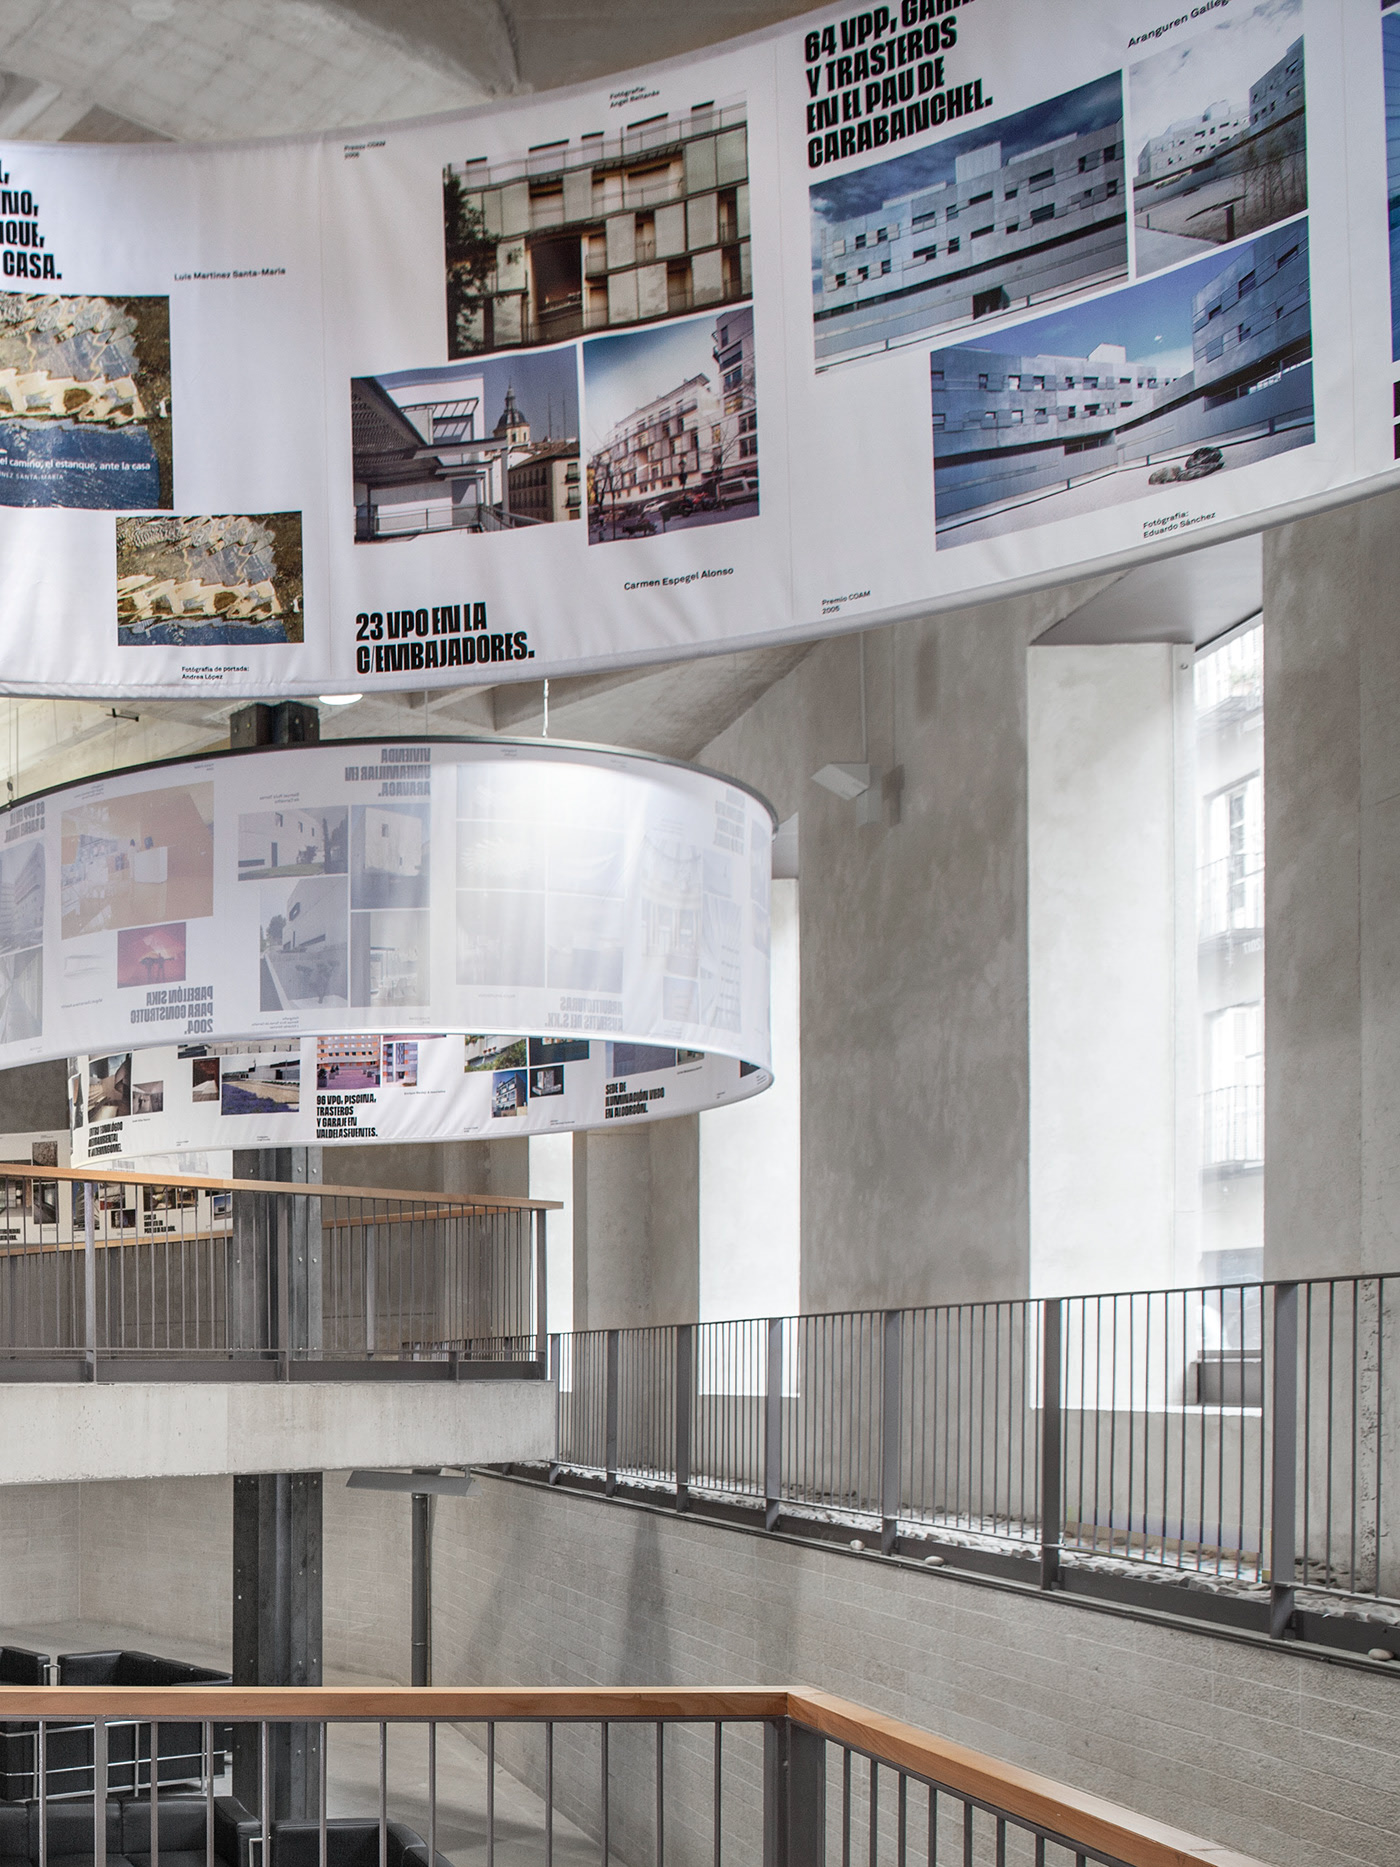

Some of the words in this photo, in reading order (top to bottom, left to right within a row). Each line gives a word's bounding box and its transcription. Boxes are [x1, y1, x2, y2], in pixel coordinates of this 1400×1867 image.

[804, 24, 837, 62] 64
[840, 6, 898, 51] VPP,
[1128, 14, 1188, 48] Aranguren
[806, 65, 821, 98] Y
[826, 16, 957, 92] TRASTEROS
[806, 94, 839, 134] EN
[842, 87, 862, 122] EL
[866, 67, 914, 115] PAU
[918, 56, 945, 96] DE
[808, 78, 993, 168] CARABANCHEL.
[3, 250, 62, 280] CASA.
[0, 457, 8, 465] el
[10, 458, 44, 469] camino,
[46, 460, 53, 468] el
[55, 460, 97, 471] estanque,
[100, 462, 120, 470] ante
[122, 462, 130, 470] la
[132, 463, 150, 471] casa
[1143, 523, 1178, 538] Eduardo
[1180, 512, 1216, 528] Sánchez
[624, 579, 660, 590] Carmen
[662, 572, 700, 586] Espegel
[701, 568, 734, 578] Alonso
[822, 596, 848, 606] Premio
[848, 590, 871, 600] COAM
[822, 605, 840, 615] 2005
[356, 612, 384, 642] 23
[386, 608, 428, 640] VPO
[432, 604, 460, 635] EN
[464, 602, 488, 632] LA
[356, 631, 535, 674] C/EMBAJADORES.
[605, 1083, 618, 1094] SEDE
[619, 1082, 626, 1093] DE
[316, 1106, 354, 1116] TRASTEROS
[316, 1118, 321, 1127] Y
[322, 1117, 348, 1127] GARAJE
[348, 1117, 357, 1126] EN
[605, 1108, 613, 1119] EN
[316, 1127, 378, 1138] VALDELASFUENTES.
